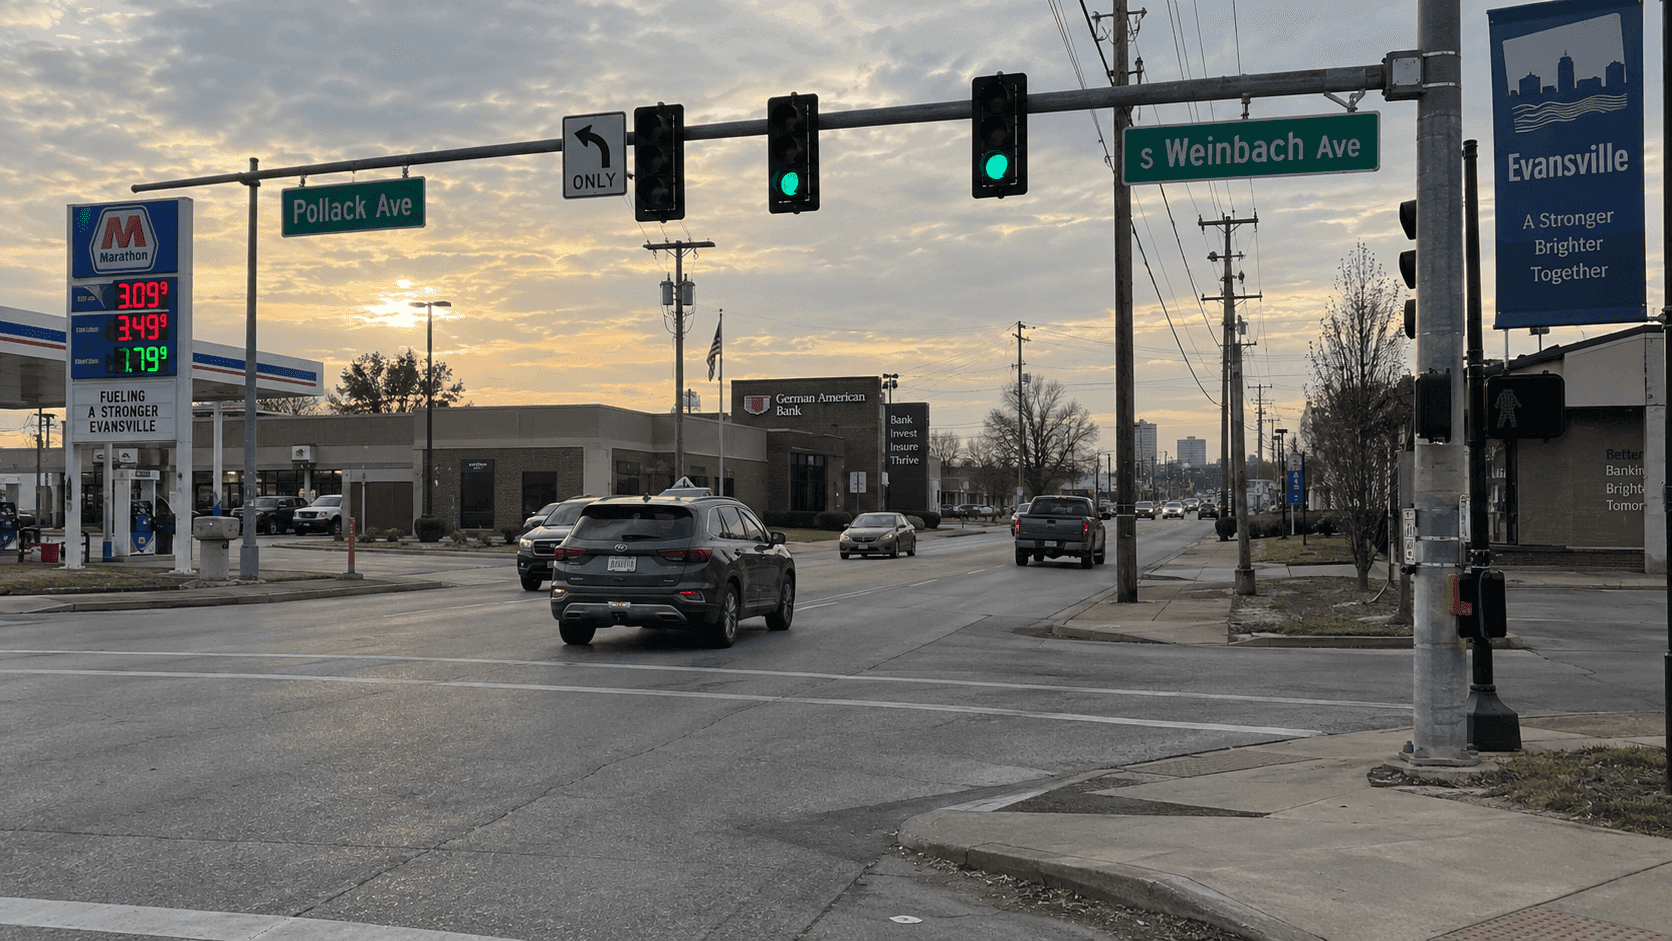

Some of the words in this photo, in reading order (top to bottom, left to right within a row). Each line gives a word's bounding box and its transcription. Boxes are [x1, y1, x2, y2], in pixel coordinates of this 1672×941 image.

[1165, 131, 1304, 168] Weinbach
[1315, 134, 1361, 160] Ave
[1508, 142, 1629, 182] Evansville
[573, 172, 617, 190] ONLY
[293, 194, 367, 224] Pollack
[375, 193, 413, 218] Ave
[1522, 213, 1535, 230] A
[1539, 210, 1614, 229] Stronger
[1534, 236, 1604, 258] Brighter
[99, 250, 148, 263] Marathon
[1530, 262, 1609, 285] Together
[100, 390, 146, 403] FUELING
[775, 393, 816, 404] German
[817, 391, 866, 403] American
[88, 406, 96, 418] A
[101, 405, 158, 418] STRONGER
[776, 405, 802, 416] Bank
[890, 414, 913, 425] Bank
[89, 420, 156, 433] EVANSVILLE
[890, 428, 918, 438] Invest
[890, 442, 919, 452] Insure
[890, 454, 920, 465] Thrive
[1606, 448, 1644, 460] Better
